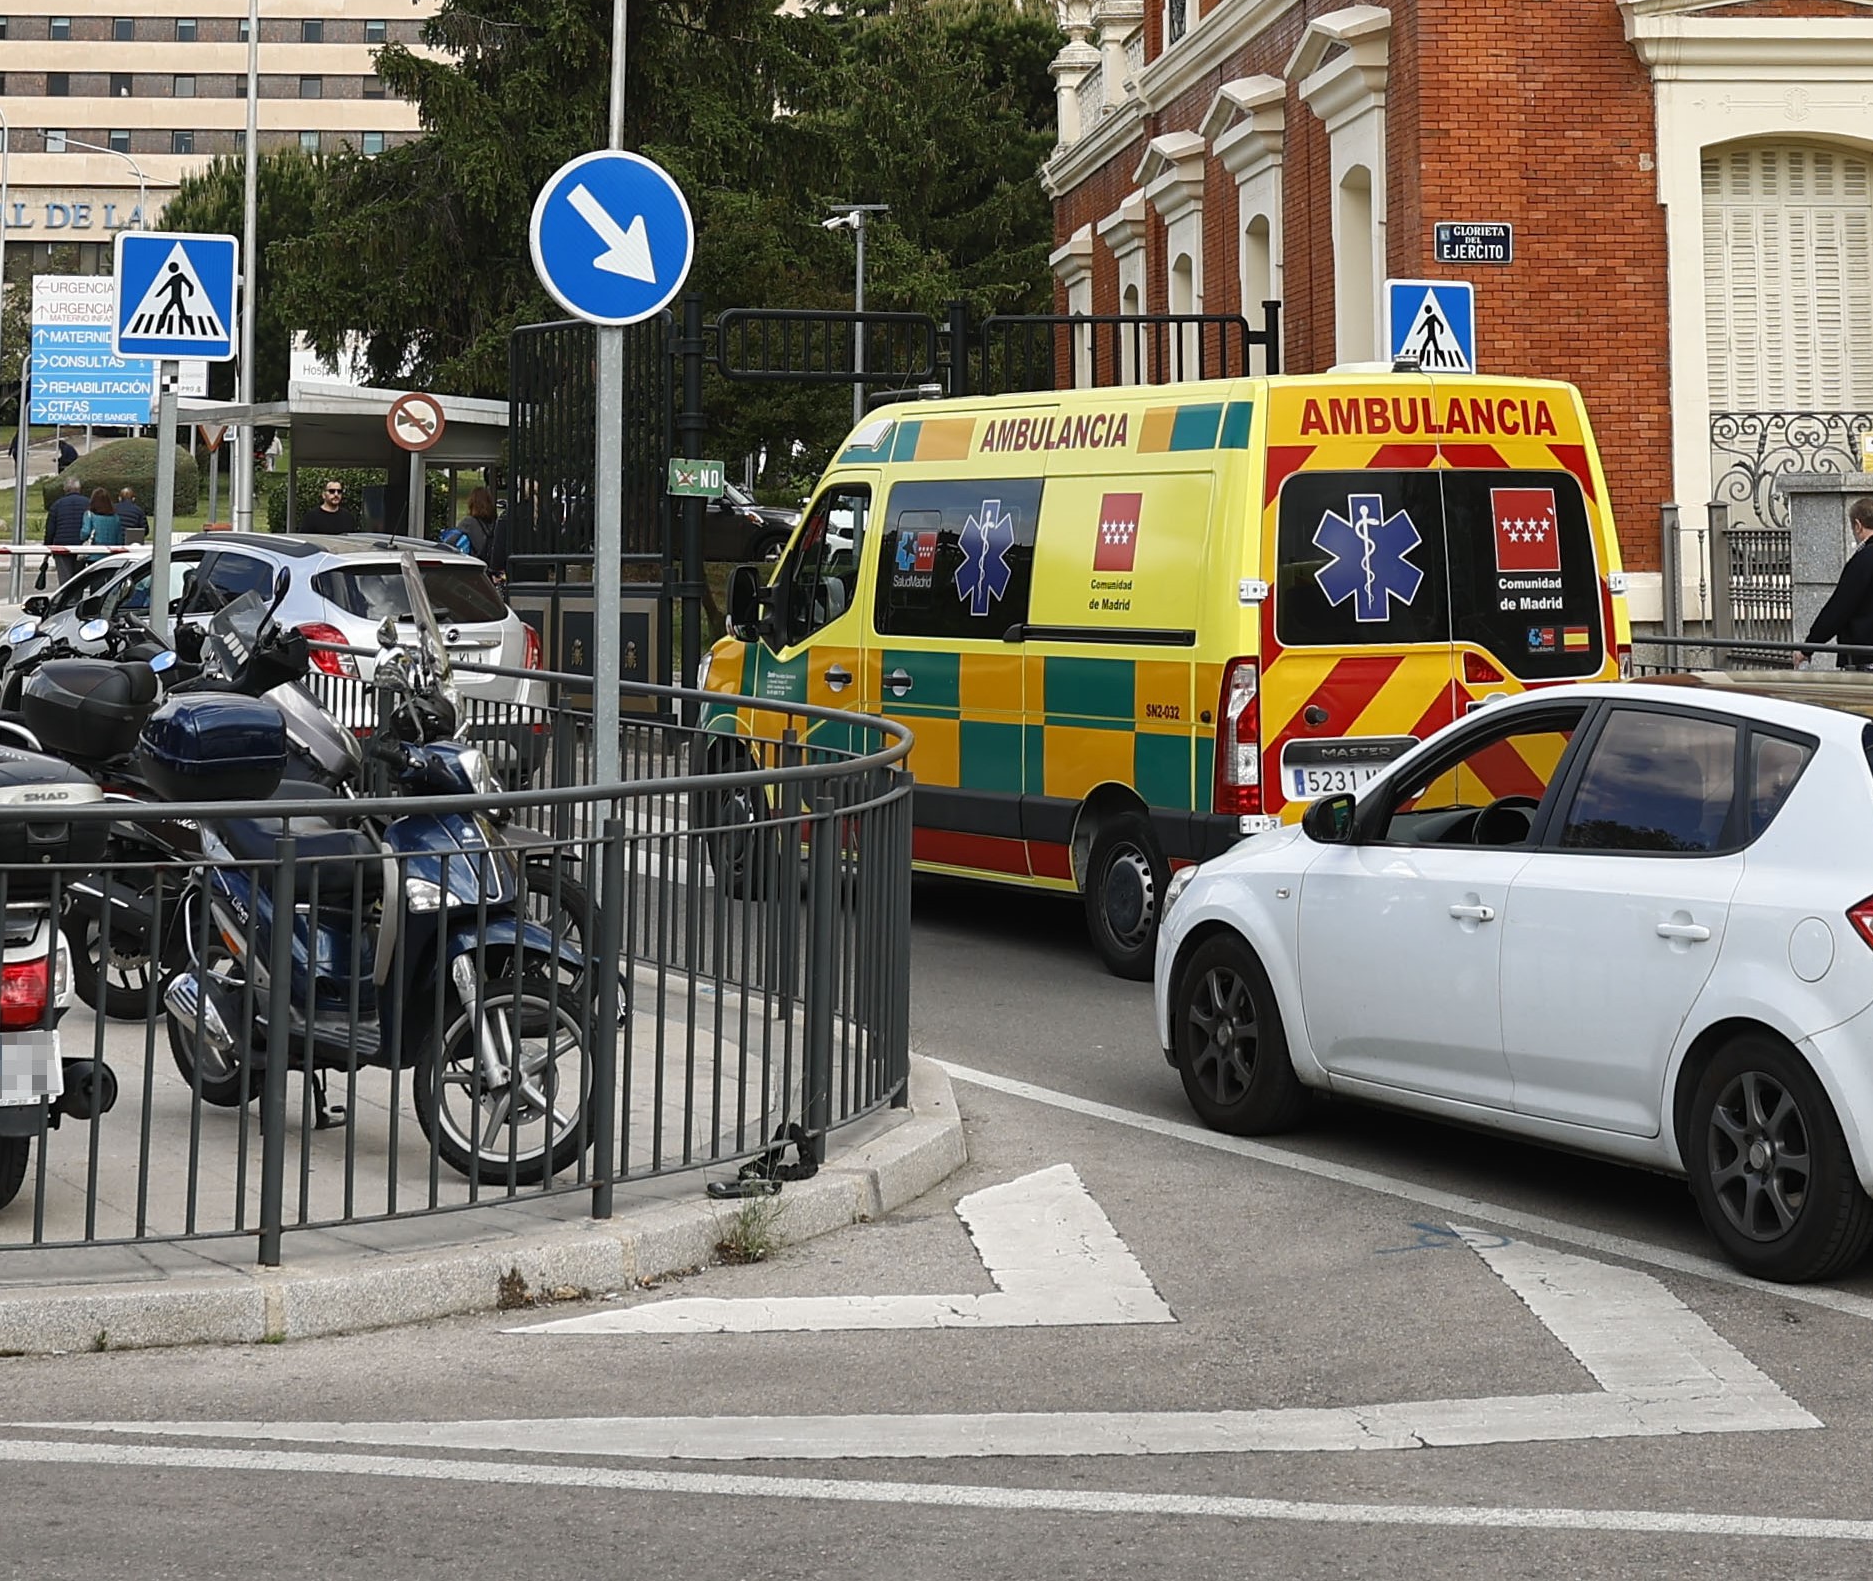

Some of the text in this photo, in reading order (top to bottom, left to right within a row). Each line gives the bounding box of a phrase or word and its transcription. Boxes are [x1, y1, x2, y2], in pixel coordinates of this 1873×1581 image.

[46, 203, 93, 229] DE
[103, 203, 143, 229] LA
[1453, 226, 1505, 236] GLORIETA
[1443, 245, 1503, 259] EJERCITO
[50, 283, 114, 293] URGENCIA
[50, 303, 113, 314] URGENCIA
[50, 314, 88, 322] MATERNO
[50, 331, 112, 344] MATERNID
[49, 356, 125, 368] CONSULTAS
[50, 380, 150, 394] REHABILITACIÓN
[48, 401, 89, 412] CTFAS
[48, 412, 137, 421] DONACIÓN DE SANGRE
[1299, 398, 1558, 437] AMBULANCIA
[979, 413, 1128, 453] AMBULANCIA
[700, 470, 718, 488] NO
[893, 575, 931, 588] SaludMadrid
[1091, 579, 1133, 591] Comunidad
[1498, 577, 1562, 589] Comunidad
[1089, 599, 1130, 611] de Madrid
[1500, 597, 1563, 610] de Madrid
[1145, 703, 1180, 720] SN2-032
[1321, 747, 1391, 757] MASTER
[1308, 770, 1357, 792] 5231
[23, 792, 69, 802] SHAD
